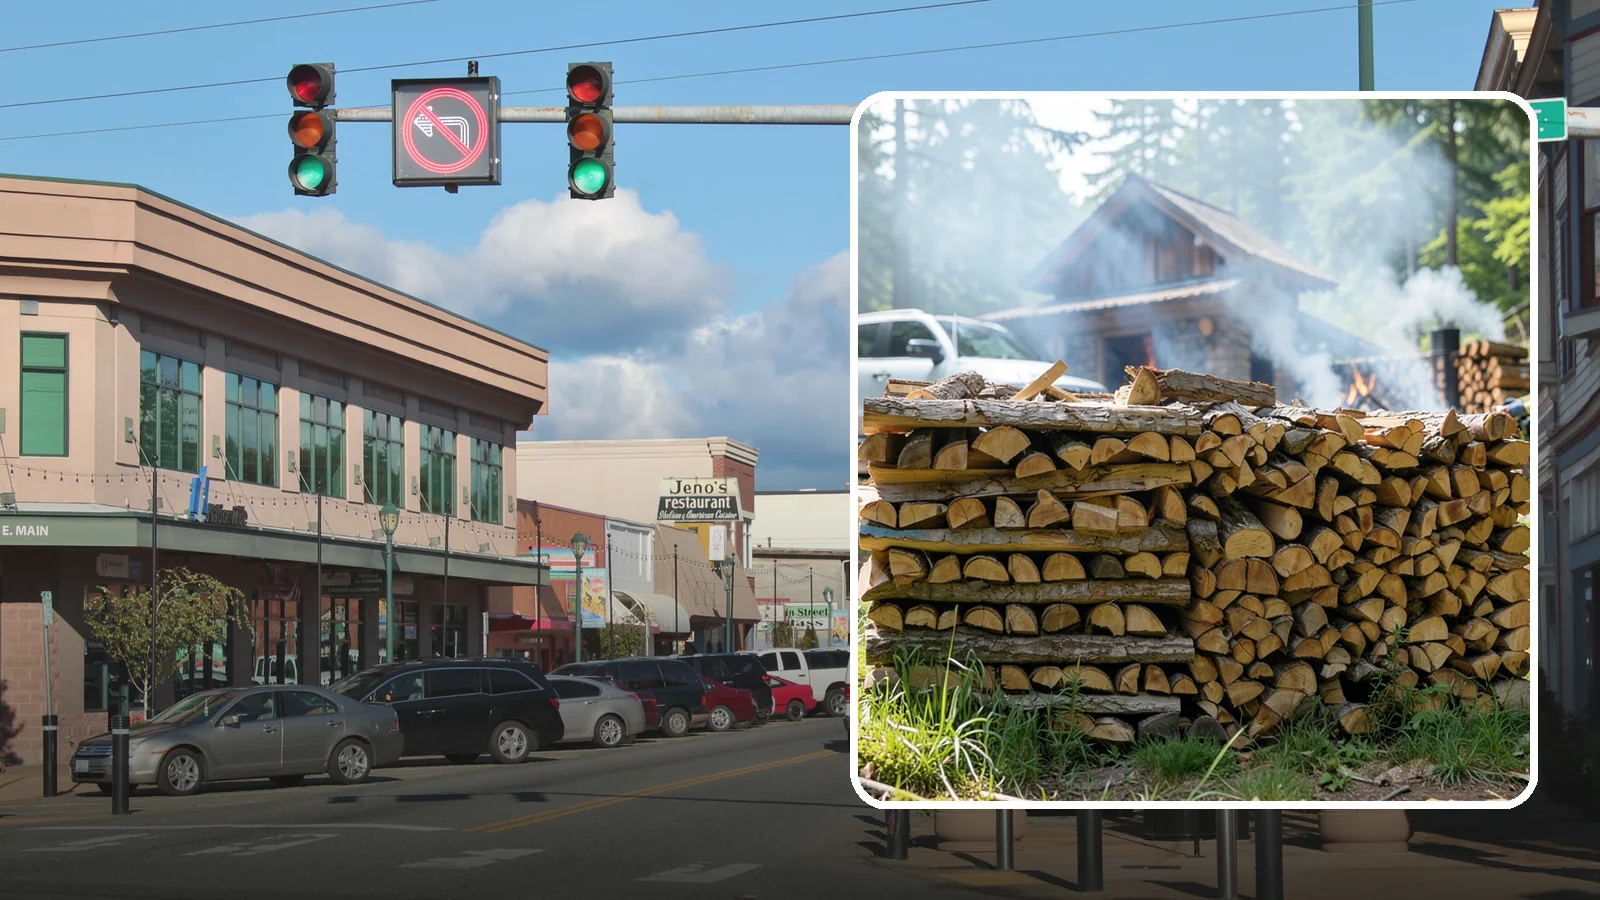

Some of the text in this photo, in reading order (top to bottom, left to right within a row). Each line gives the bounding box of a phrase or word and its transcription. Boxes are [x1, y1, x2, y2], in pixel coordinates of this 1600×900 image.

[670, 480, 727, 494] Jeno's
[665, 496, 730, 509] restaurant
[659, 510, 682, 520] Italian
[686, 510, 714, 519] American
[715, 510, 737, 519] Cuisine
[2, 525, 49, 536] E. MAIN
[786, 608, 795, 616] in
[797, 607, 828, 616] Street
